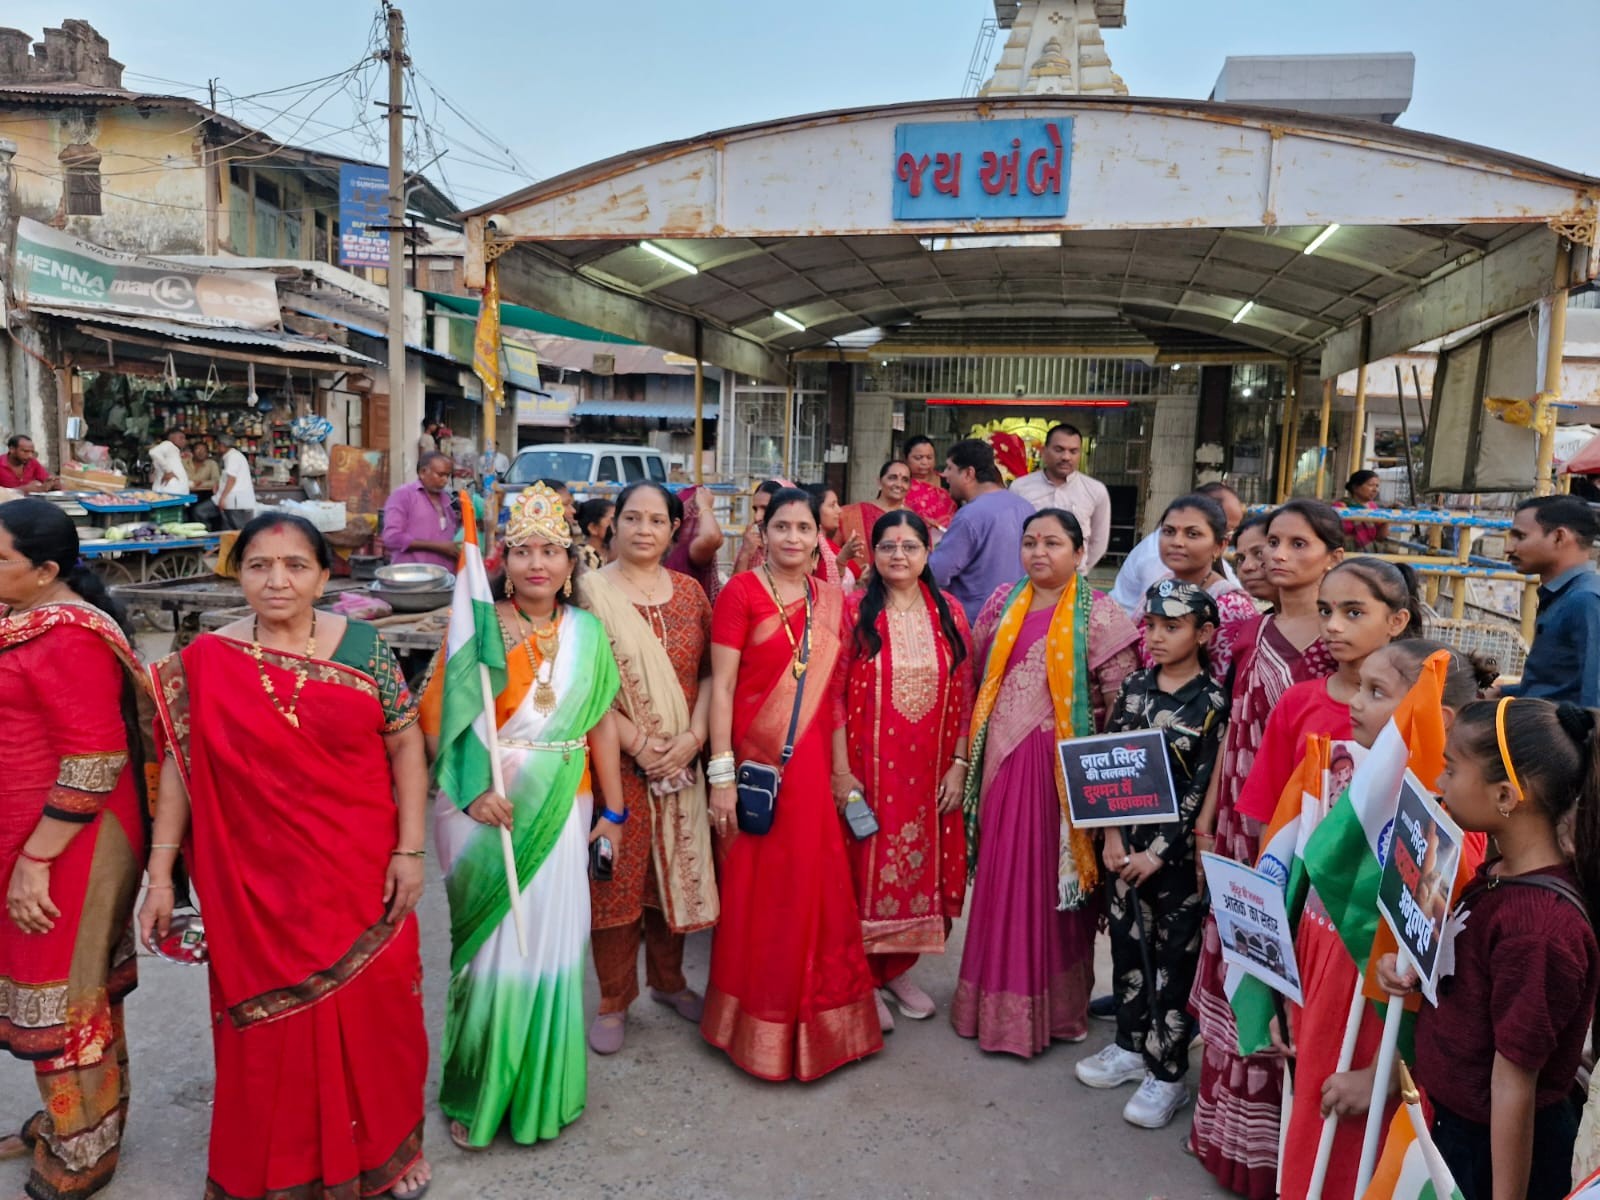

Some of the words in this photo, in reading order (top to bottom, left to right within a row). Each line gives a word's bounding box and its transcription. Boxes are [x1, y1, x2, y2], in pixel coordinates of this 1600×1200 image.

[896, 152, 962, 198] જય
[979, 123, 1063, 196] અંબે
[16, 250, 105, 290] HENNA
[61, 282, 105, 298] POLY
[1079, 751, 1110, 769] लाल
[1085, 767, 1099, 781] की
[1082, 783, 1119, 805] दुश्मन
[1120, 778, 1132, 796] में
[1107, 793, 1159, 811] हाहाकार!
